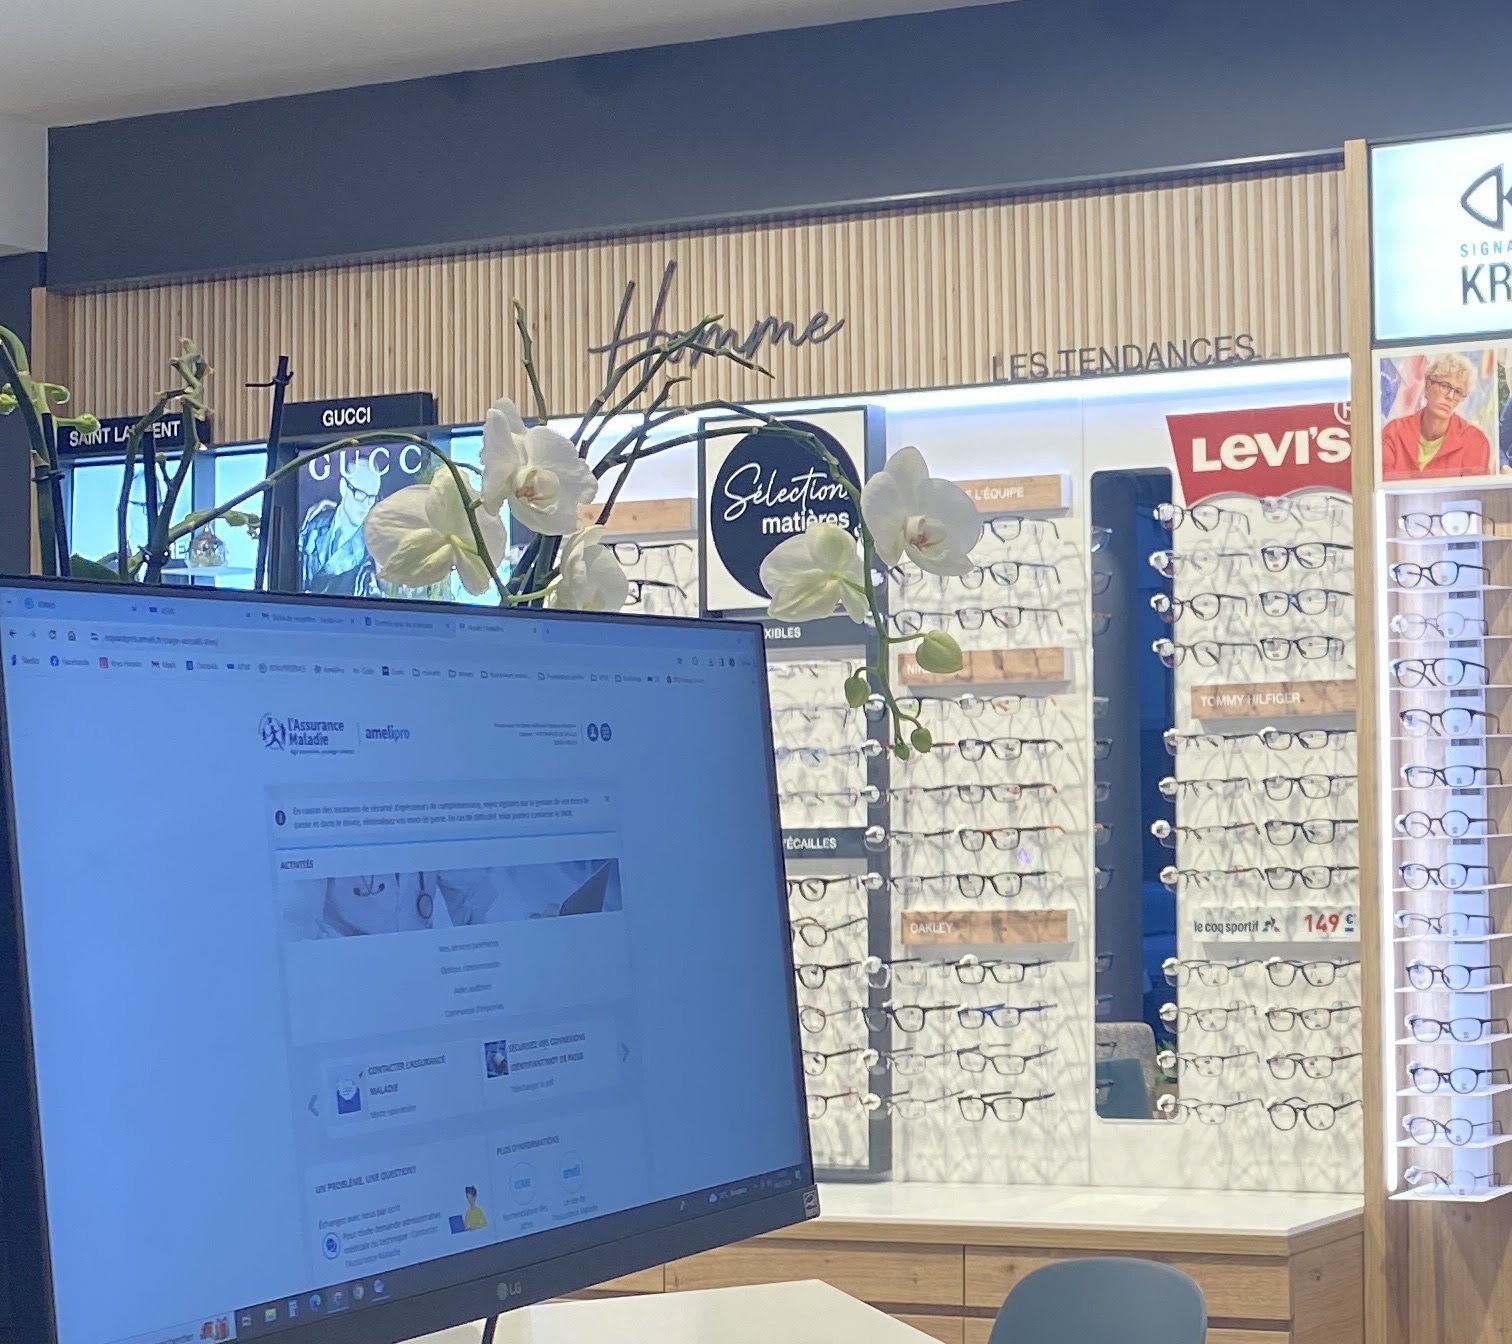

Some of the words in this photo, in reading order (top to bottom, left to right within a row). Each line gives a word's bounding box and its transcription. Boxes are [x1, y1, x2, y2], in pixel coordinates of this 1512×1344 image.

[587, 260, 845, 392] Homme
[992, 351, 1049, 383] LES
[1057, 334, 1256, 377] TENDANCES
[322, 406, 371, 427] GUCCI
[69, 427, 111, 447] SAINT
[114, 420, 180, 443] LAENT
[724, 462, 849, 521] Sélection
[974, 486, 1024, 501] L'ÉQUIPE
[762, 510, 849, 535] matières
[907, 665, 932, 675] NIK
[1200, 694, 1244, 707] TOMMY
[1247, 692, 1301, 705] HILFIGER
[287, 717, 344, 731] l'Assurance
[365, 724, 410, 742] amelipro
[289, 732, 329, 745] Maladie
[910, 921, 953, 935] OAKLEY
[1194, 920, 1203, 932] le
[1205, 923, 1223, 934] coq
[1225, 920, 1259, 935] sportif
[1304, 913, 1340, 933] 149
[510, 1281, 522, 1295] LG
